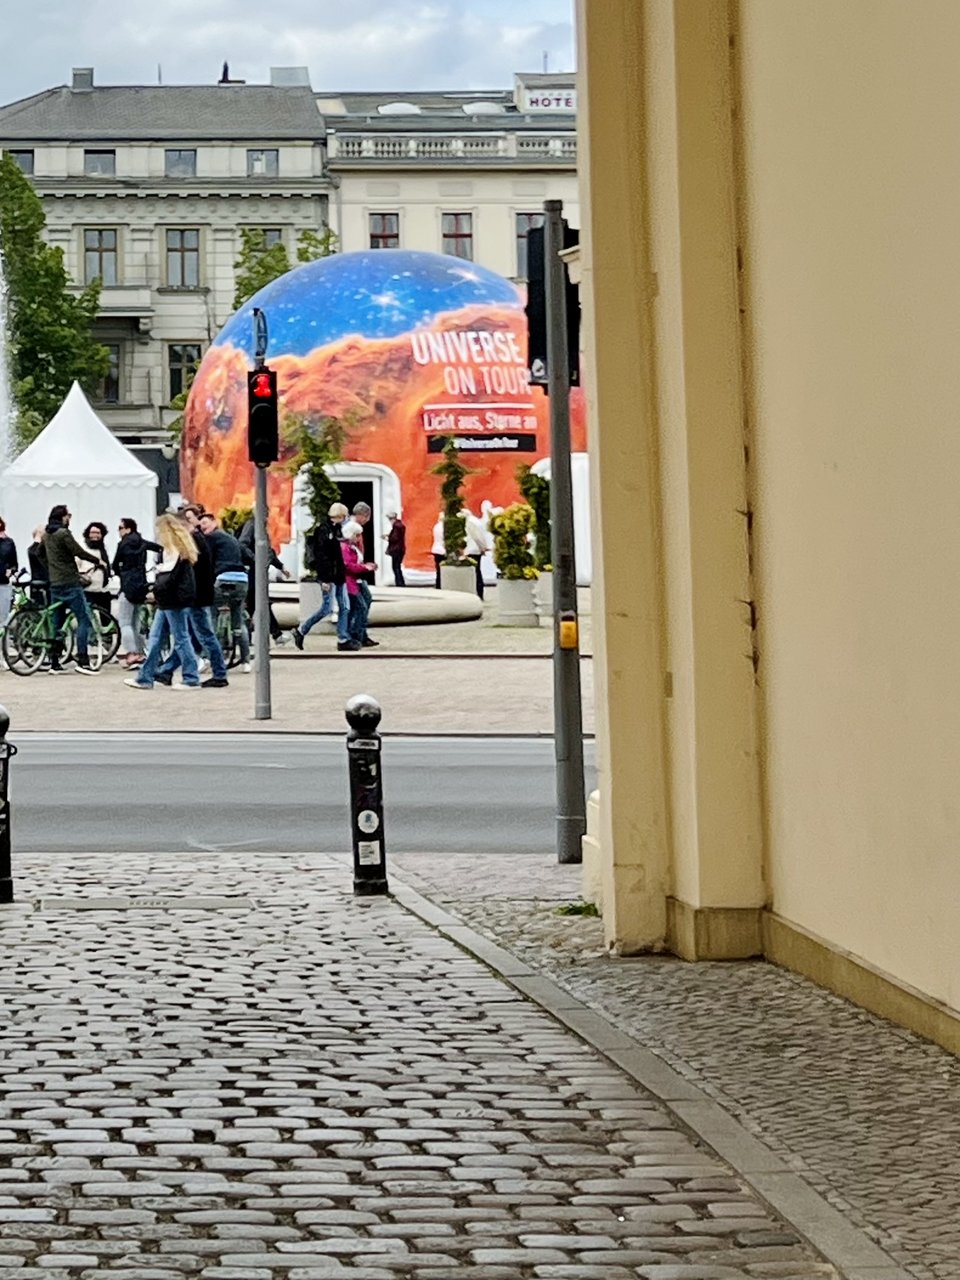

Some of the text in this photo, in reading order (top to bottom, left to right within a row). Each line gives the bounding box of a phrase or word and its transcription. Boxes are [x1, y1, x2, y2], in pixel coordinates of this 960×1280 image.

[529, 97, 573, 107] HOTE
[411, 331, 524, 364] UNIVERSE
[444, 366, 533, 395] ON TOUR
[423, 412, 456, 431] Licht
[485, 412, 522, 431] Sterne
